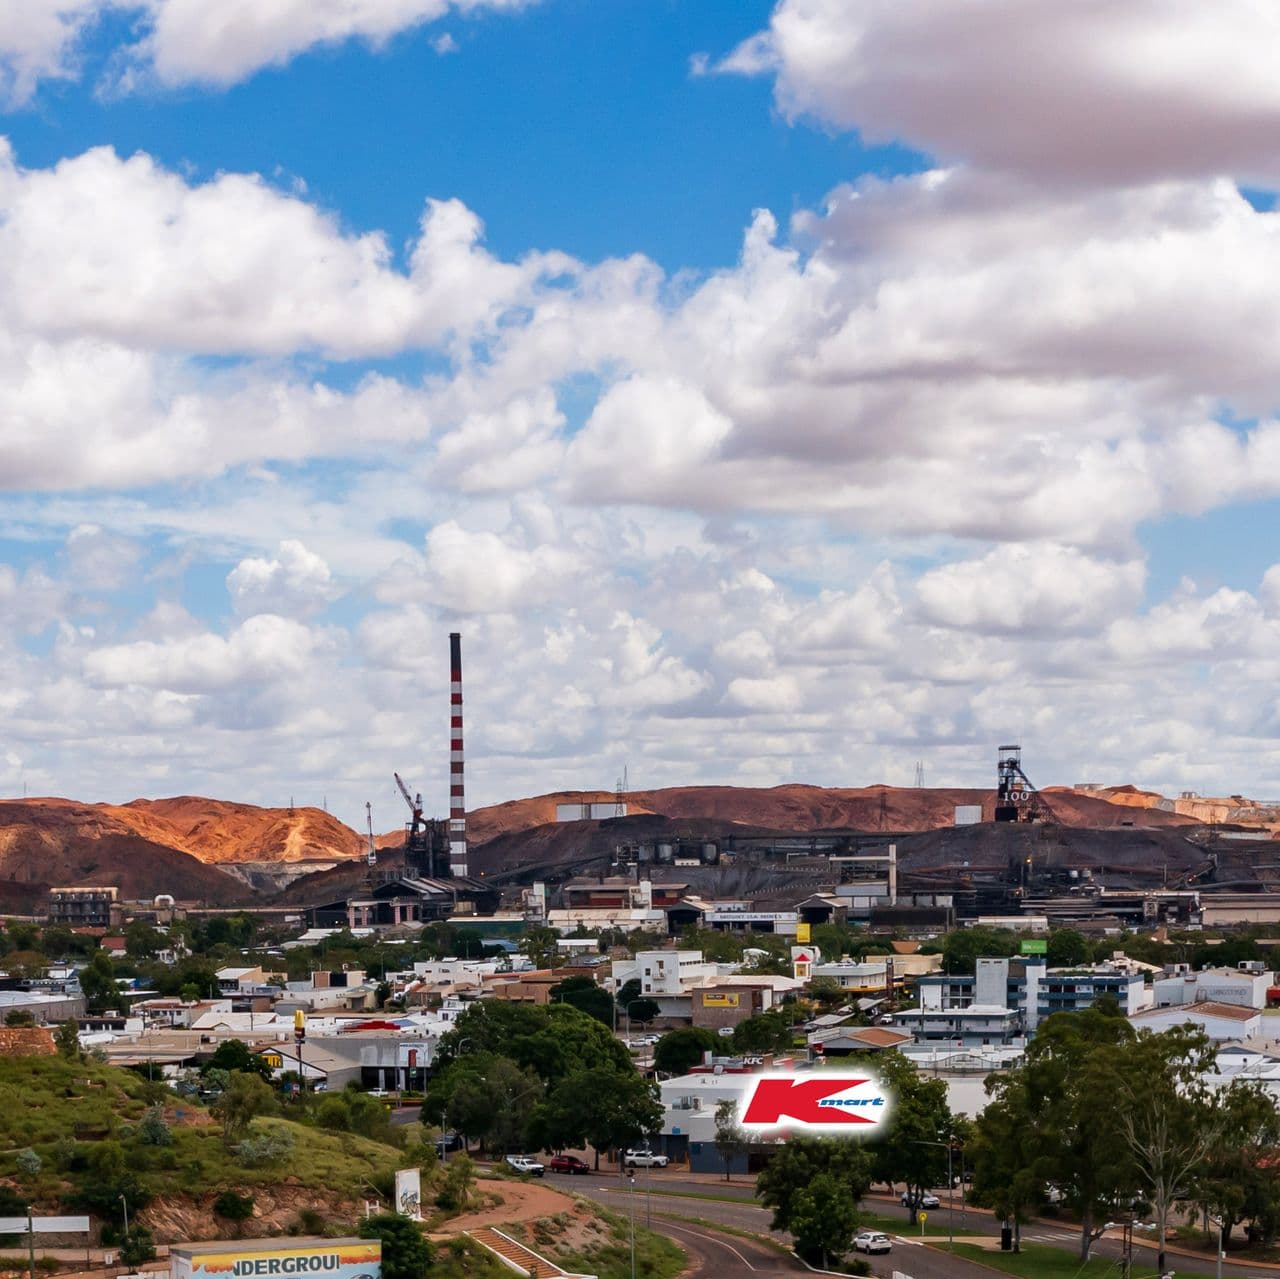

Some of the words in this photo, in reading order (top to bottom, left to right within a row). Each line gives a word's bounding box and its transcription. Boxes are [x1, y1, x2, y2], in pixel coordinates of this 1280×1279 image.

[1004, 792, 1029, 801] 100
[743, 1057, 764, 1065] KFC
[232, 1255, 340, 1276] NDERGROU
